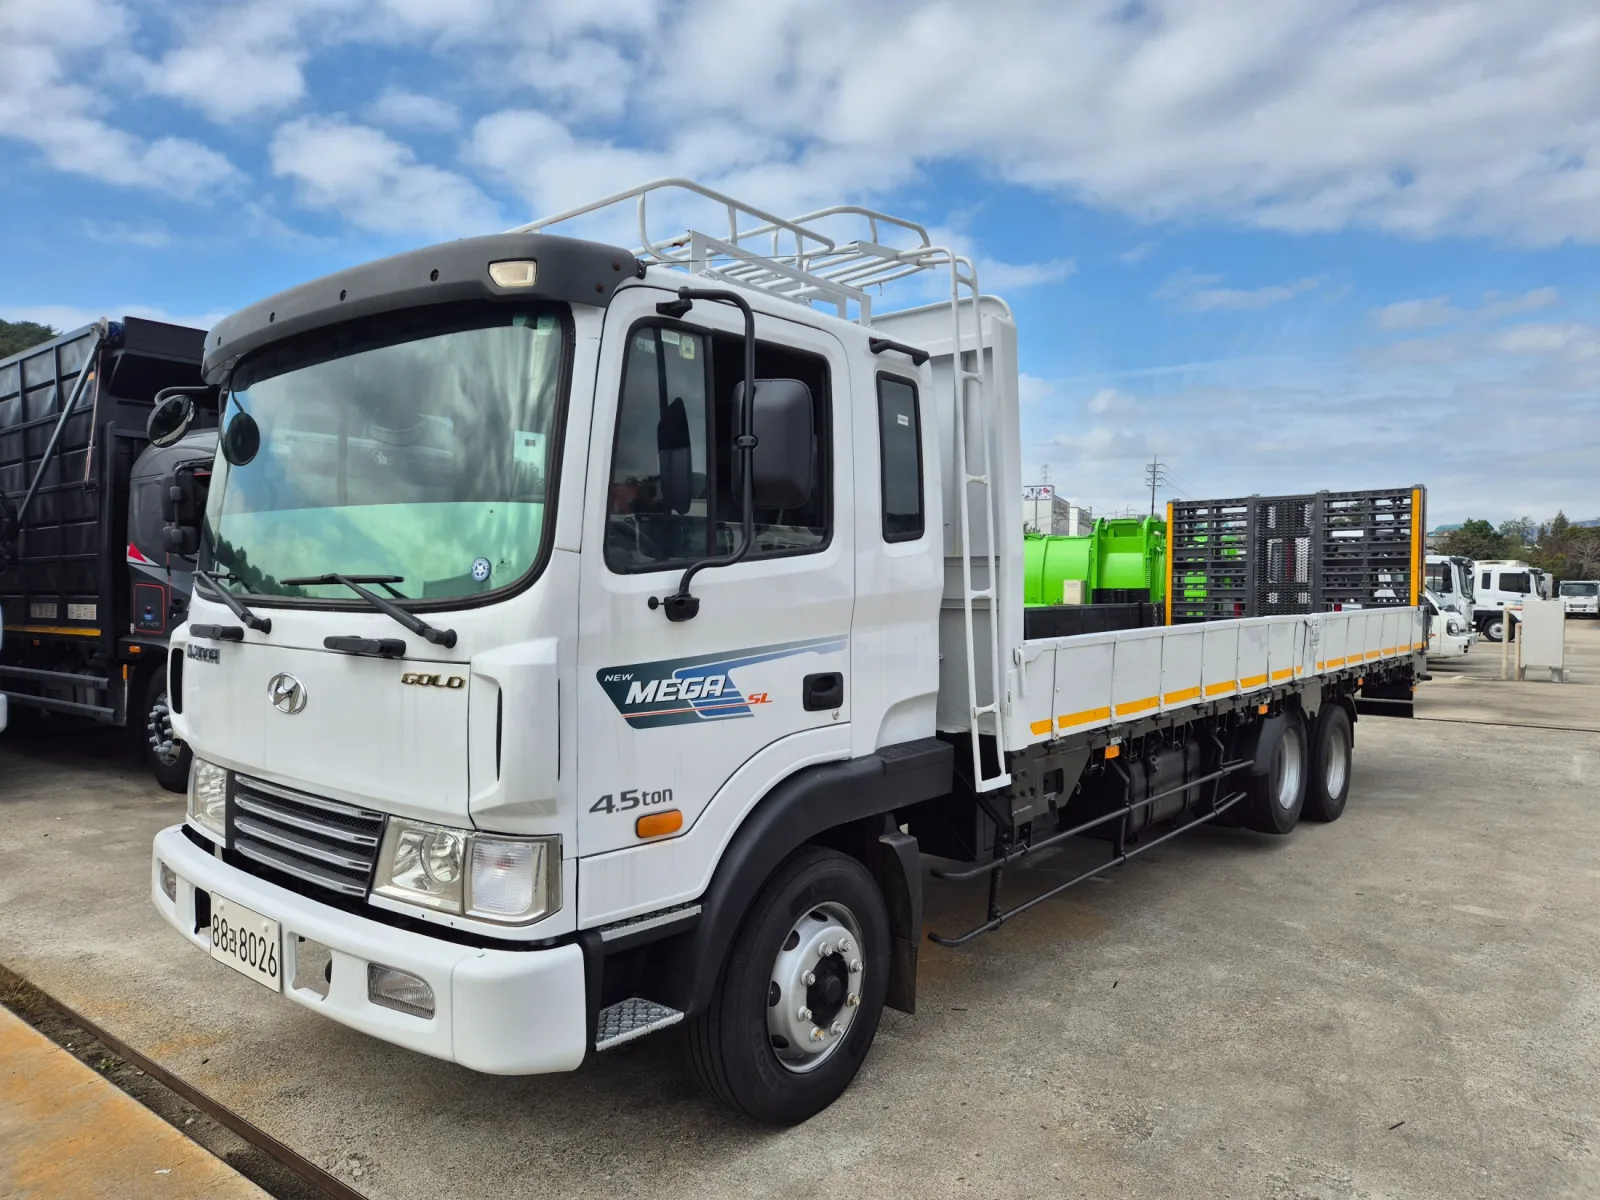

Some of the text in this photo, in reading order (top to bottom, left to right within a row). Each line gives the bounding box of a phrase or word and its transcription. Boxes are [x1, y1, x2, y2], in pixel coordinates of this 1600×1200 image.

[401, 673, 466, 688] GOLD
[604, 672, 634, 682] NEW
[625, 675, 727, 706] MEGA
[747, 692, 773, 705] SL
[212, 913, 278, 978] 88라8026
